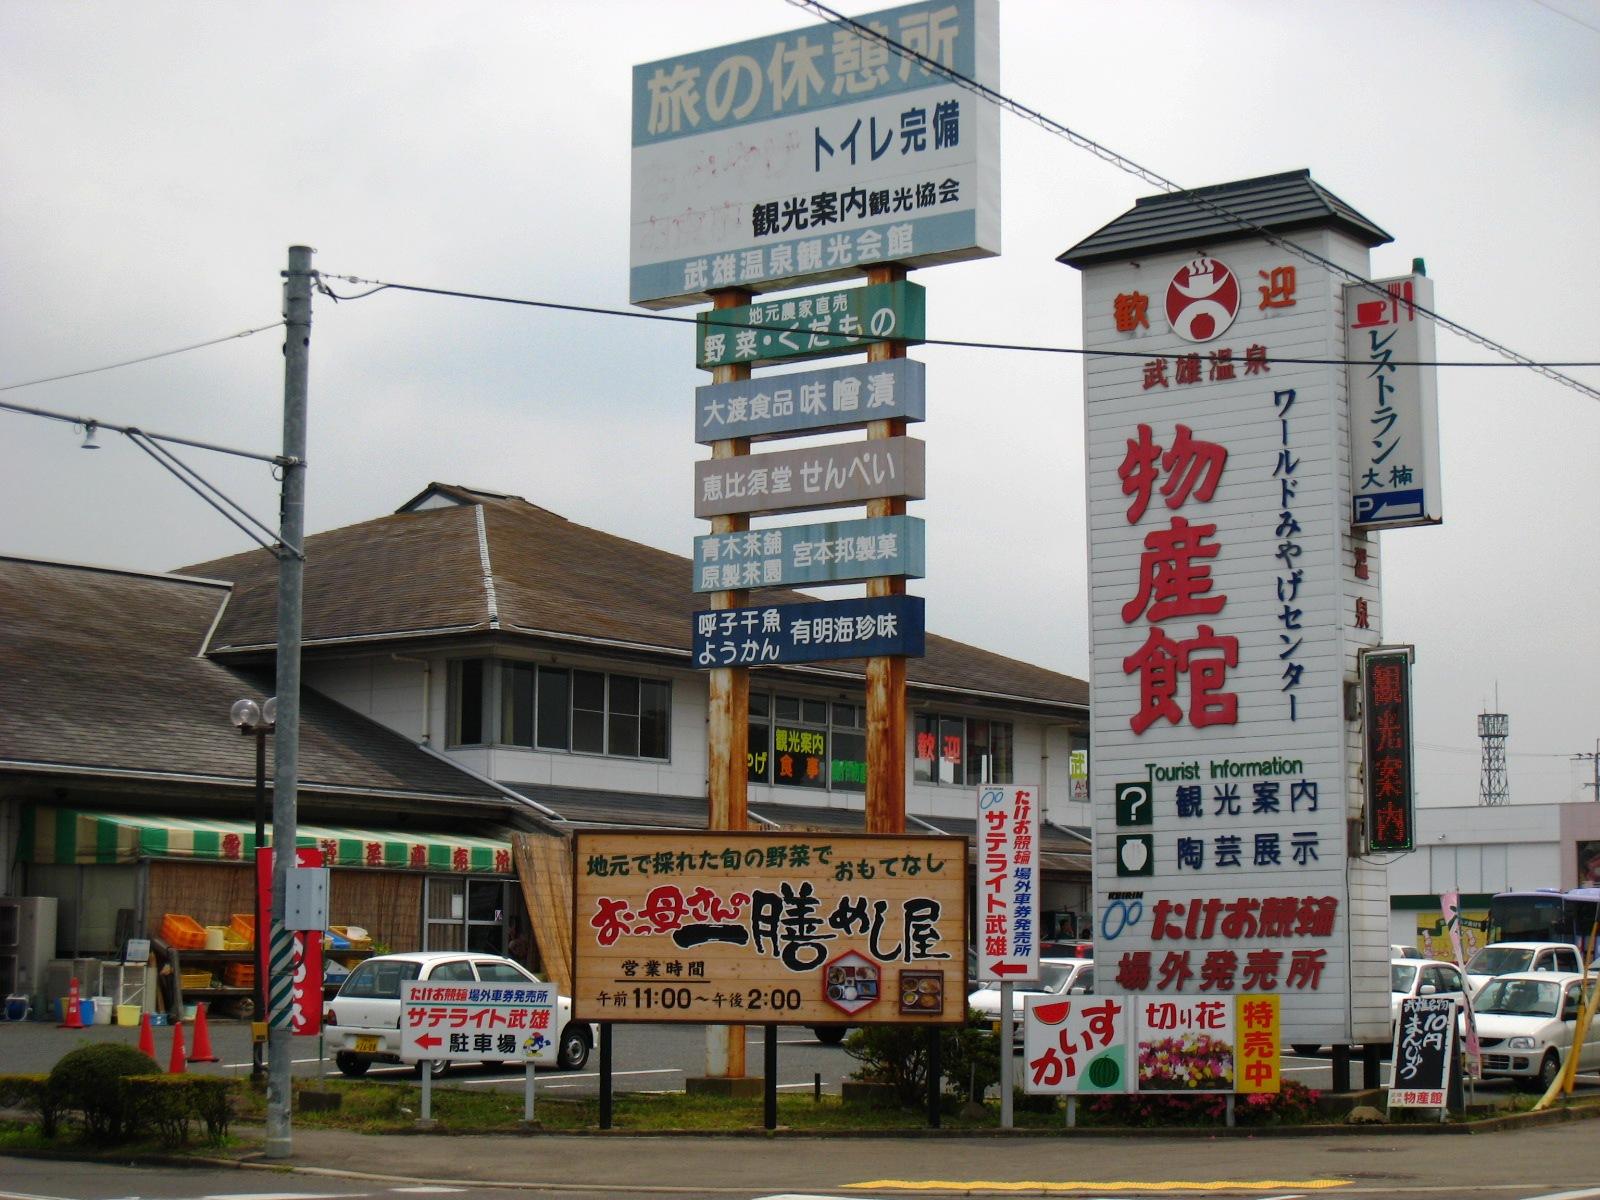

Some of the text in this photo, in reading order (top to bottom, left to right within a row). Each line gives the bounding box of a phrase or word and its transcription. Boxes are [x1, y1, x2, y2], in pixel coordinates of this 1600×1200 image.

[647, 4, 959, 136] 旅の休憩所
[813, 100, 960, 172] トイレ完備
[683, 224, 914, 291] 武雄温泉観光会館
[749, 294, 848, 325] 地元農家直売
[1142, 344, 1270, 391] 武雄温泉
[703, 389, 793, 428] 大渡食品
[1367, 328, 1402, 465] レストラン
[702, 466, 792, 501] 恵比須堂
[1355, 498, 1374, 521] P
[1272, 388, 1304, 722] ワールドみやげセンター
[701, 559, 782, 589] 原製茶園
[1117, 423, 1239, 735] 物産館
[698, 608, 898, 645] 呼子干魚 有明海珍味
[698, 638, 780, 665] ようかん
[776, 728, 824, 755] 観光案内
[1145, 757, 1303, 782] Tourist Information
[1176, 779, 1318, 818] 観光案内
[587, 844, 945, 881] 地元で採れた旬の野菜で おもてなし
[1177, 832, 1319, 869] 陶芸展示
[985, 810, 1008, 956] サテライト武雄
[1151, 896, 1338, 940] たけお競輪
[621, 960, 705, 977] 営業時間
[1116, 949, 1328, 991] 場外発売所
[408, 1008, 550, 1029] サテライト武雄
[1146, 1001, 1225, 1030] 切り花
[449, 1033, 516, 1053] 駐車場
[1030, 999, 1122, 1086] すいか
[1243, 1001, 1274, 1087] 特売中
[1404, 1091, 1442, 1104] 物産館
